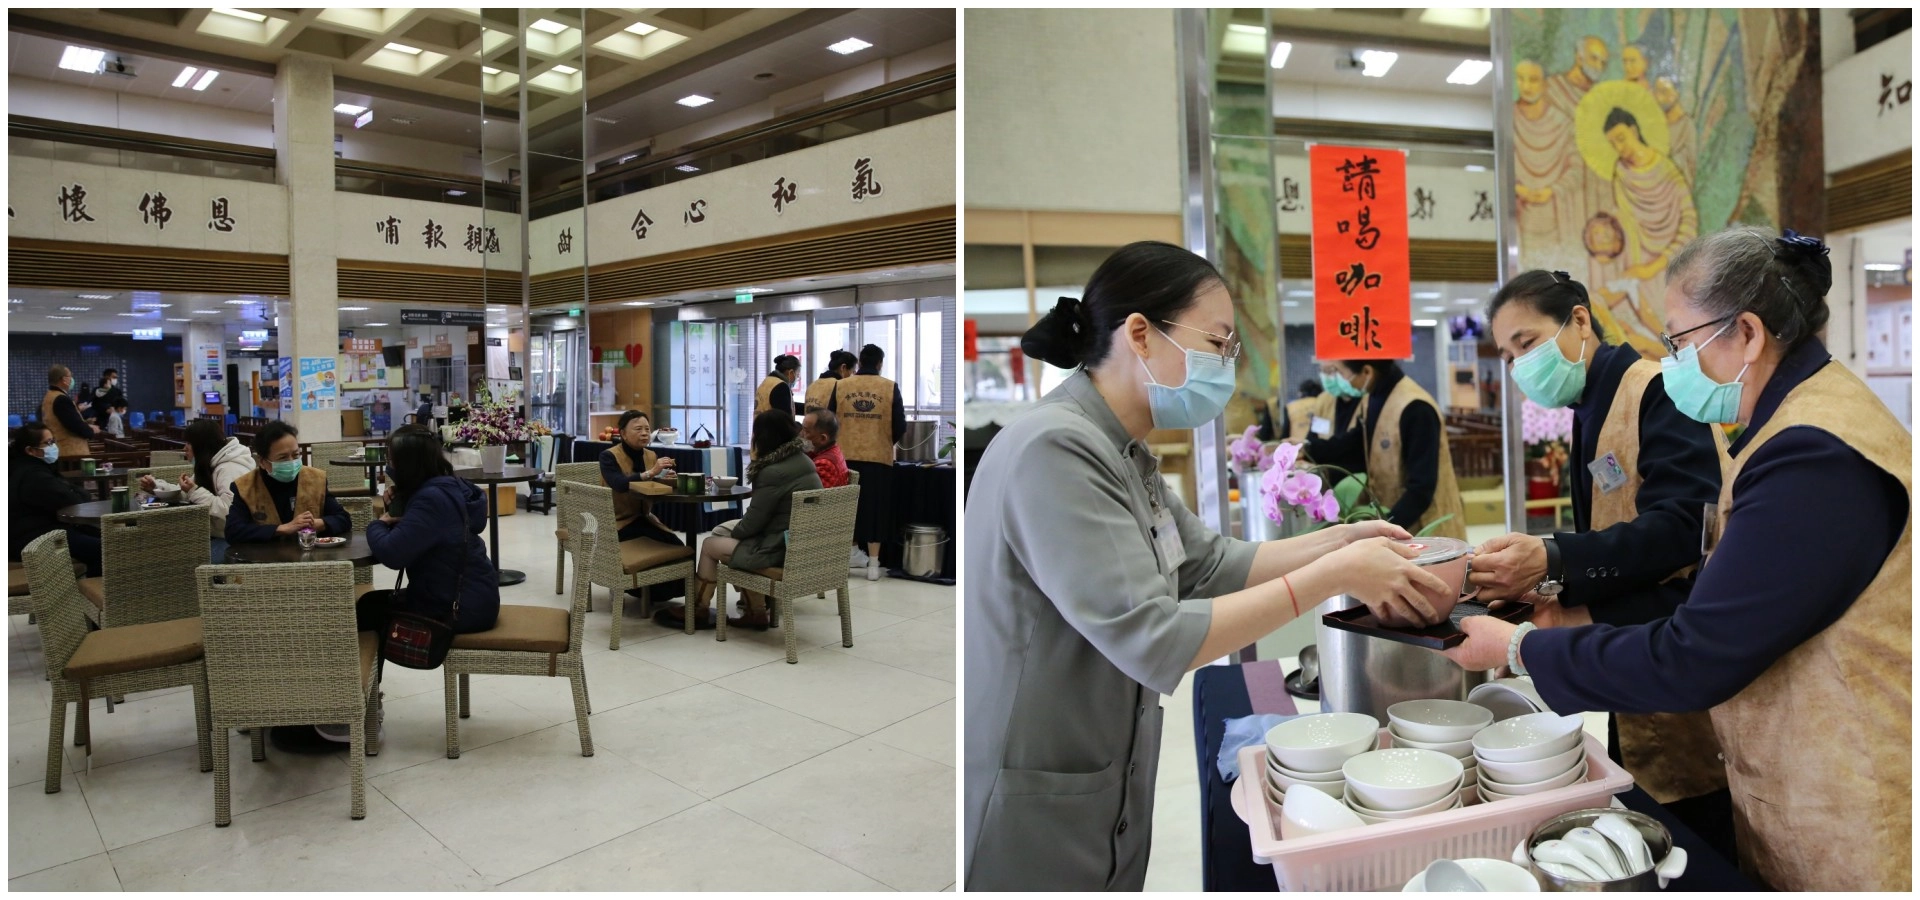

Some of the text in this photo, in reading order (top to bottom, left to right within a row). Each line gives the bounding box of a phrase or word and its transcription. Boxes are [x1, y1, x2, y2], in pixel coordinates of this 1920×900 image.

[1878, 74, 1912, 118] 知
[7, 183, 237, 233] 懷佛恩
[1335, 154, 1382, 351] 請喝咖啡
